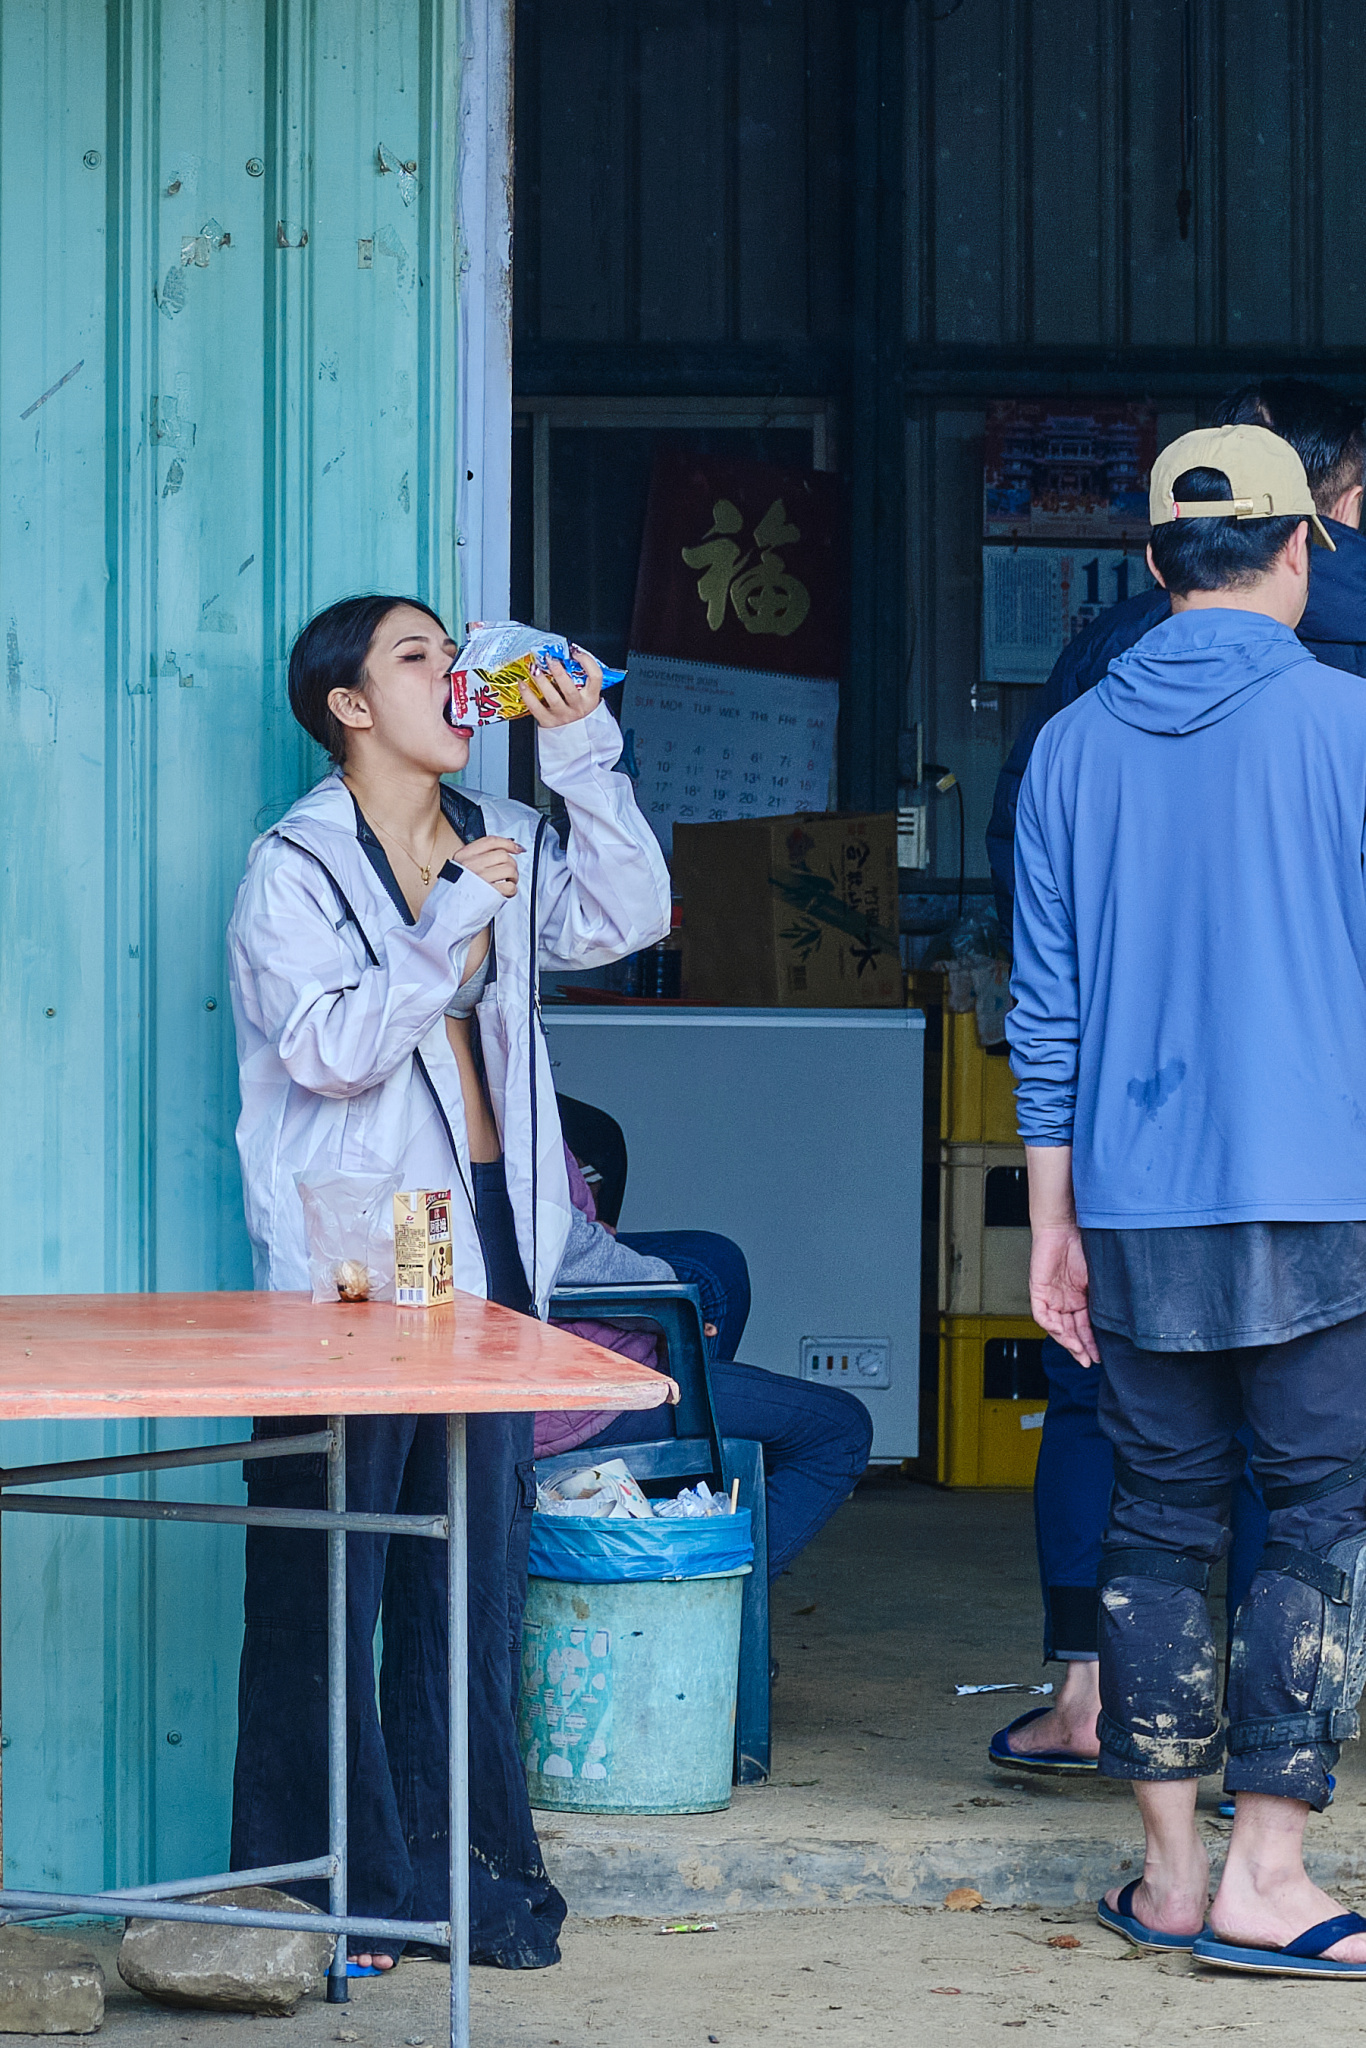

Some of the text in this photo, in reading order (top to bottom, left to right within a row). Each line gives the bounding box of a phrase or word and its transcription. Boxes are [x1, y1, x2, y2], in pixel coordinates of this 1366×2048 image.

[1082, 557, 1129, 604] 11
[639, 667, 695, 684] NOVEMBER
[657, 760, 670, 773] 10
[684, 785, 697, 797] 18
[713, 789, 726, 801] 19
[739, 792, 754, 804] 20
[767, 796, 781, 808] 21
[651, 801, 665, 813] 24
[679, 804, 694, 817] 25
